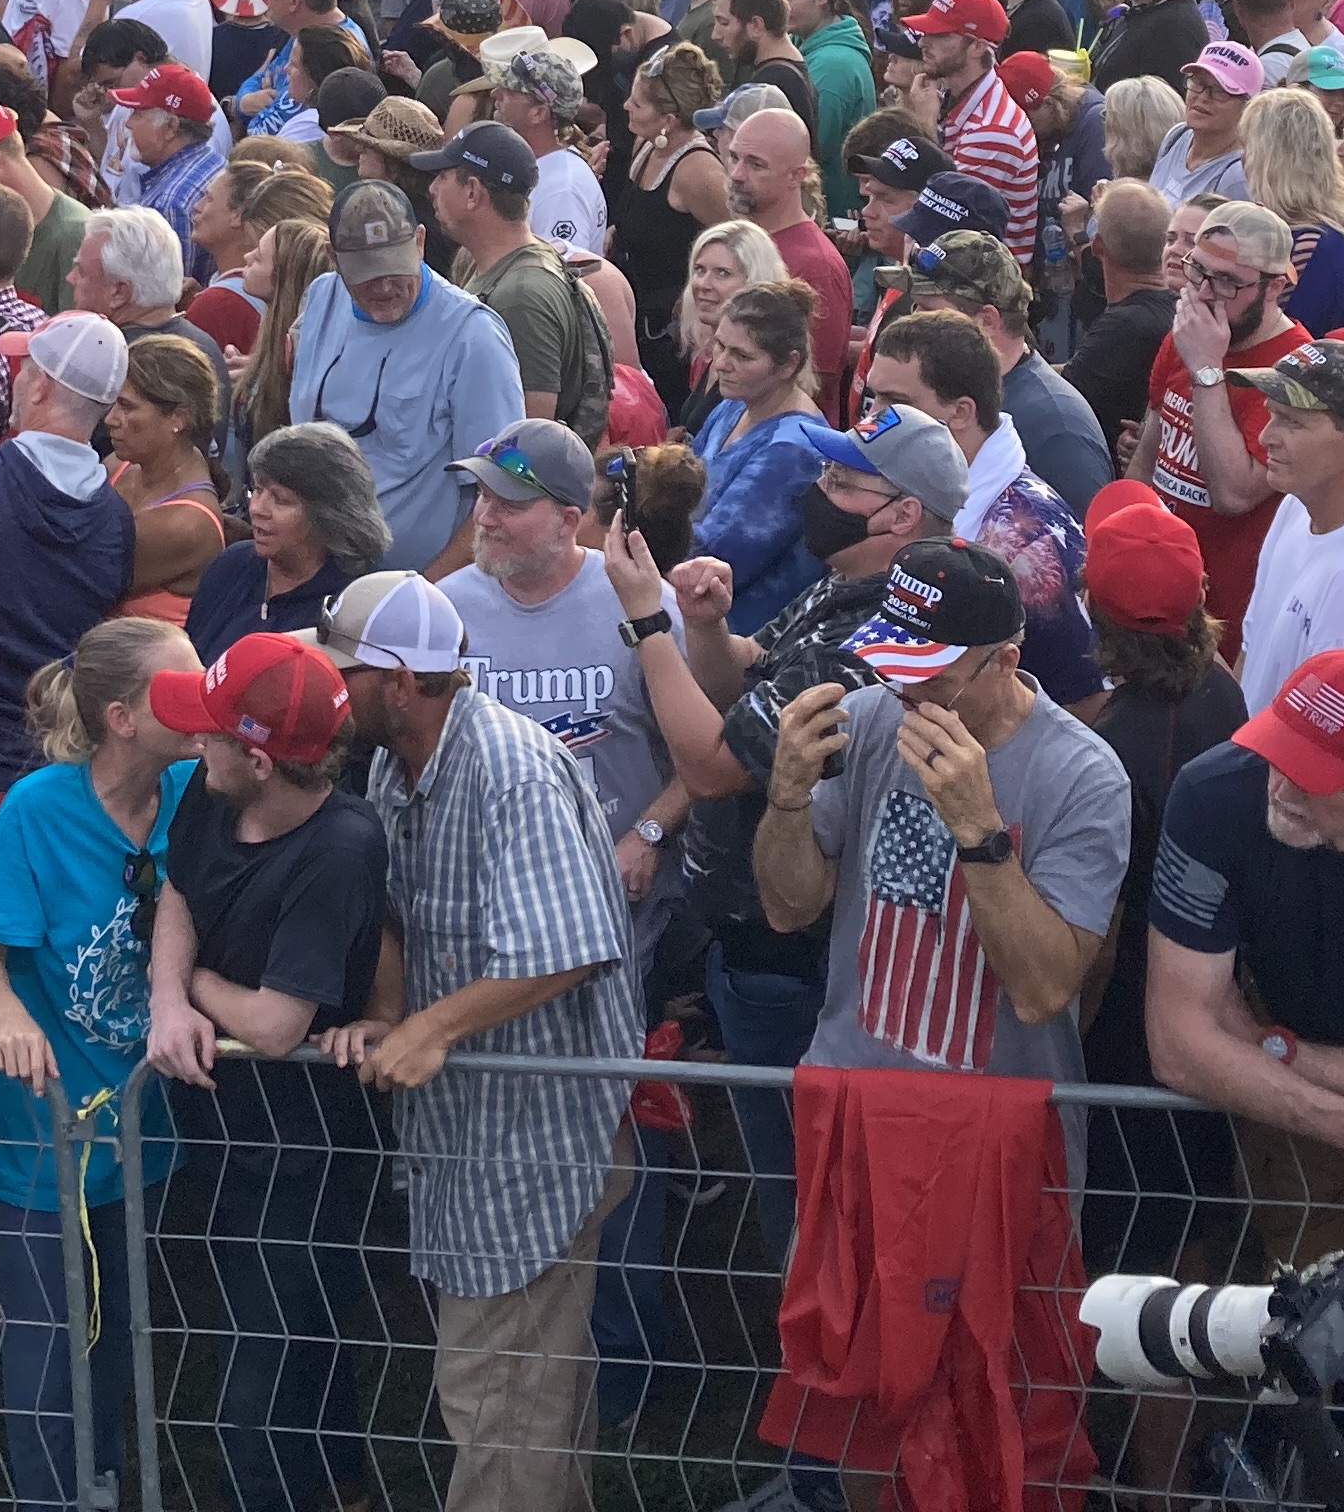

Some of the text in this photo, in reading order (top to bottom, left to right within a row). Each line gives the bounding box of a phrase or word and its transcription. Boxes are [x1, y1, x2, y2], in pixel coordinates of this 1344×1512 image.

[1206, 47, 1250, 67] TRUMP
[165, 94, 183, 109] 45
[887, 138, 919, 161] UMP
[1298, 344, 1327, 366] ump
[1163, 388, 1194, 418] MERIC
[1159, 420, 1201, 472] RUM
[1179, 486, 1208, 504] BACK
[889, 563, 943, 609] Trump
[887, 593, 918, 616] 2020
[460, 656, 615, 715] Trump
